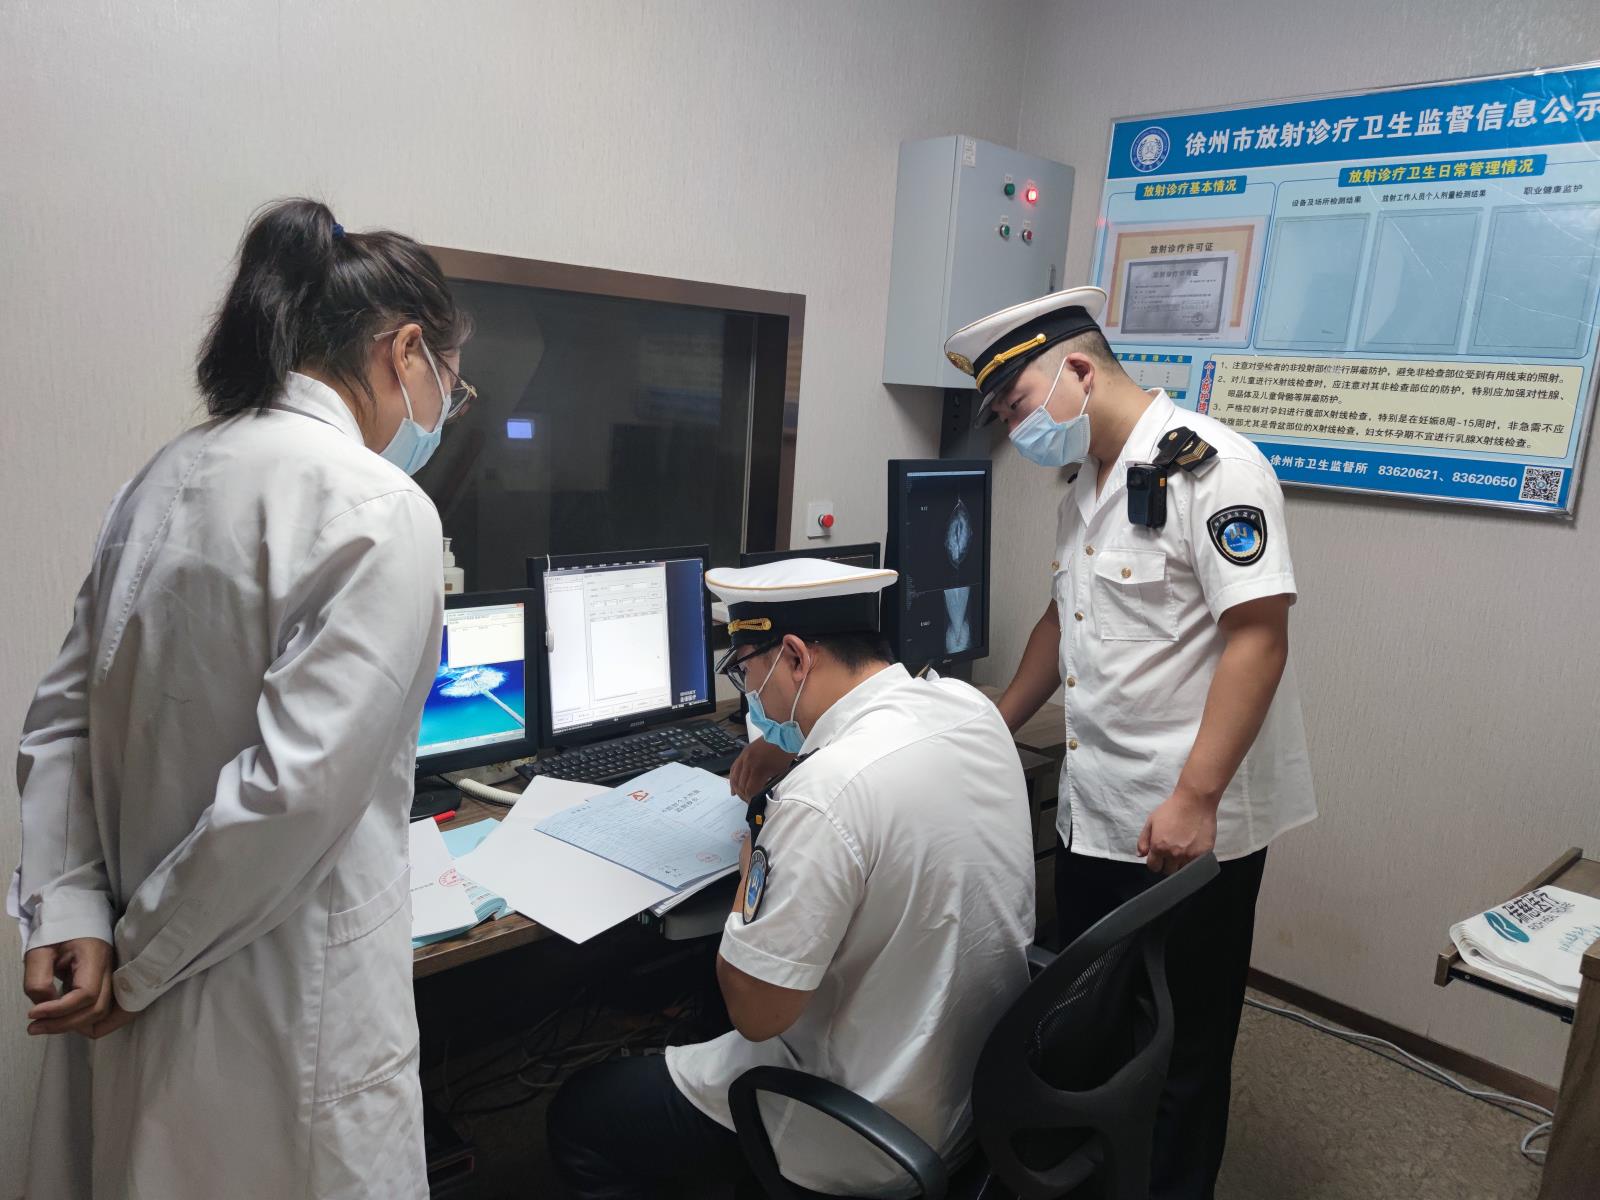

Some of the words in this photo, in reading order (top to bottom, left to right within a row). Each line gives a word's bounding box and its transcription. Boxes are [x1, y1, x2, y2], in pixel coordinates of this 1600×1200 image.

[1184, 92, 1600, 158] 徐州市放射诊疗卫生监督信息公示
[1347, 159, 1535, 184] 放射诊疗卫生日常管理情况
[1143, 179, 1238, 198] 放射诊疗基本情况
[1382, 189, 1487, 203] 放射工作人员个人剂量检测结果
[1523, 184, 1583, 196] 职业健康监护
[1291, 195, 1362, 207] 设备及场所检测结果
[1149, 242, 1214, 254] 放射诊疗许可证
[1197, 361, 1215, 414] 个人防护提
[1270, 454, 1368, 475] 徐州市卫生监督所
